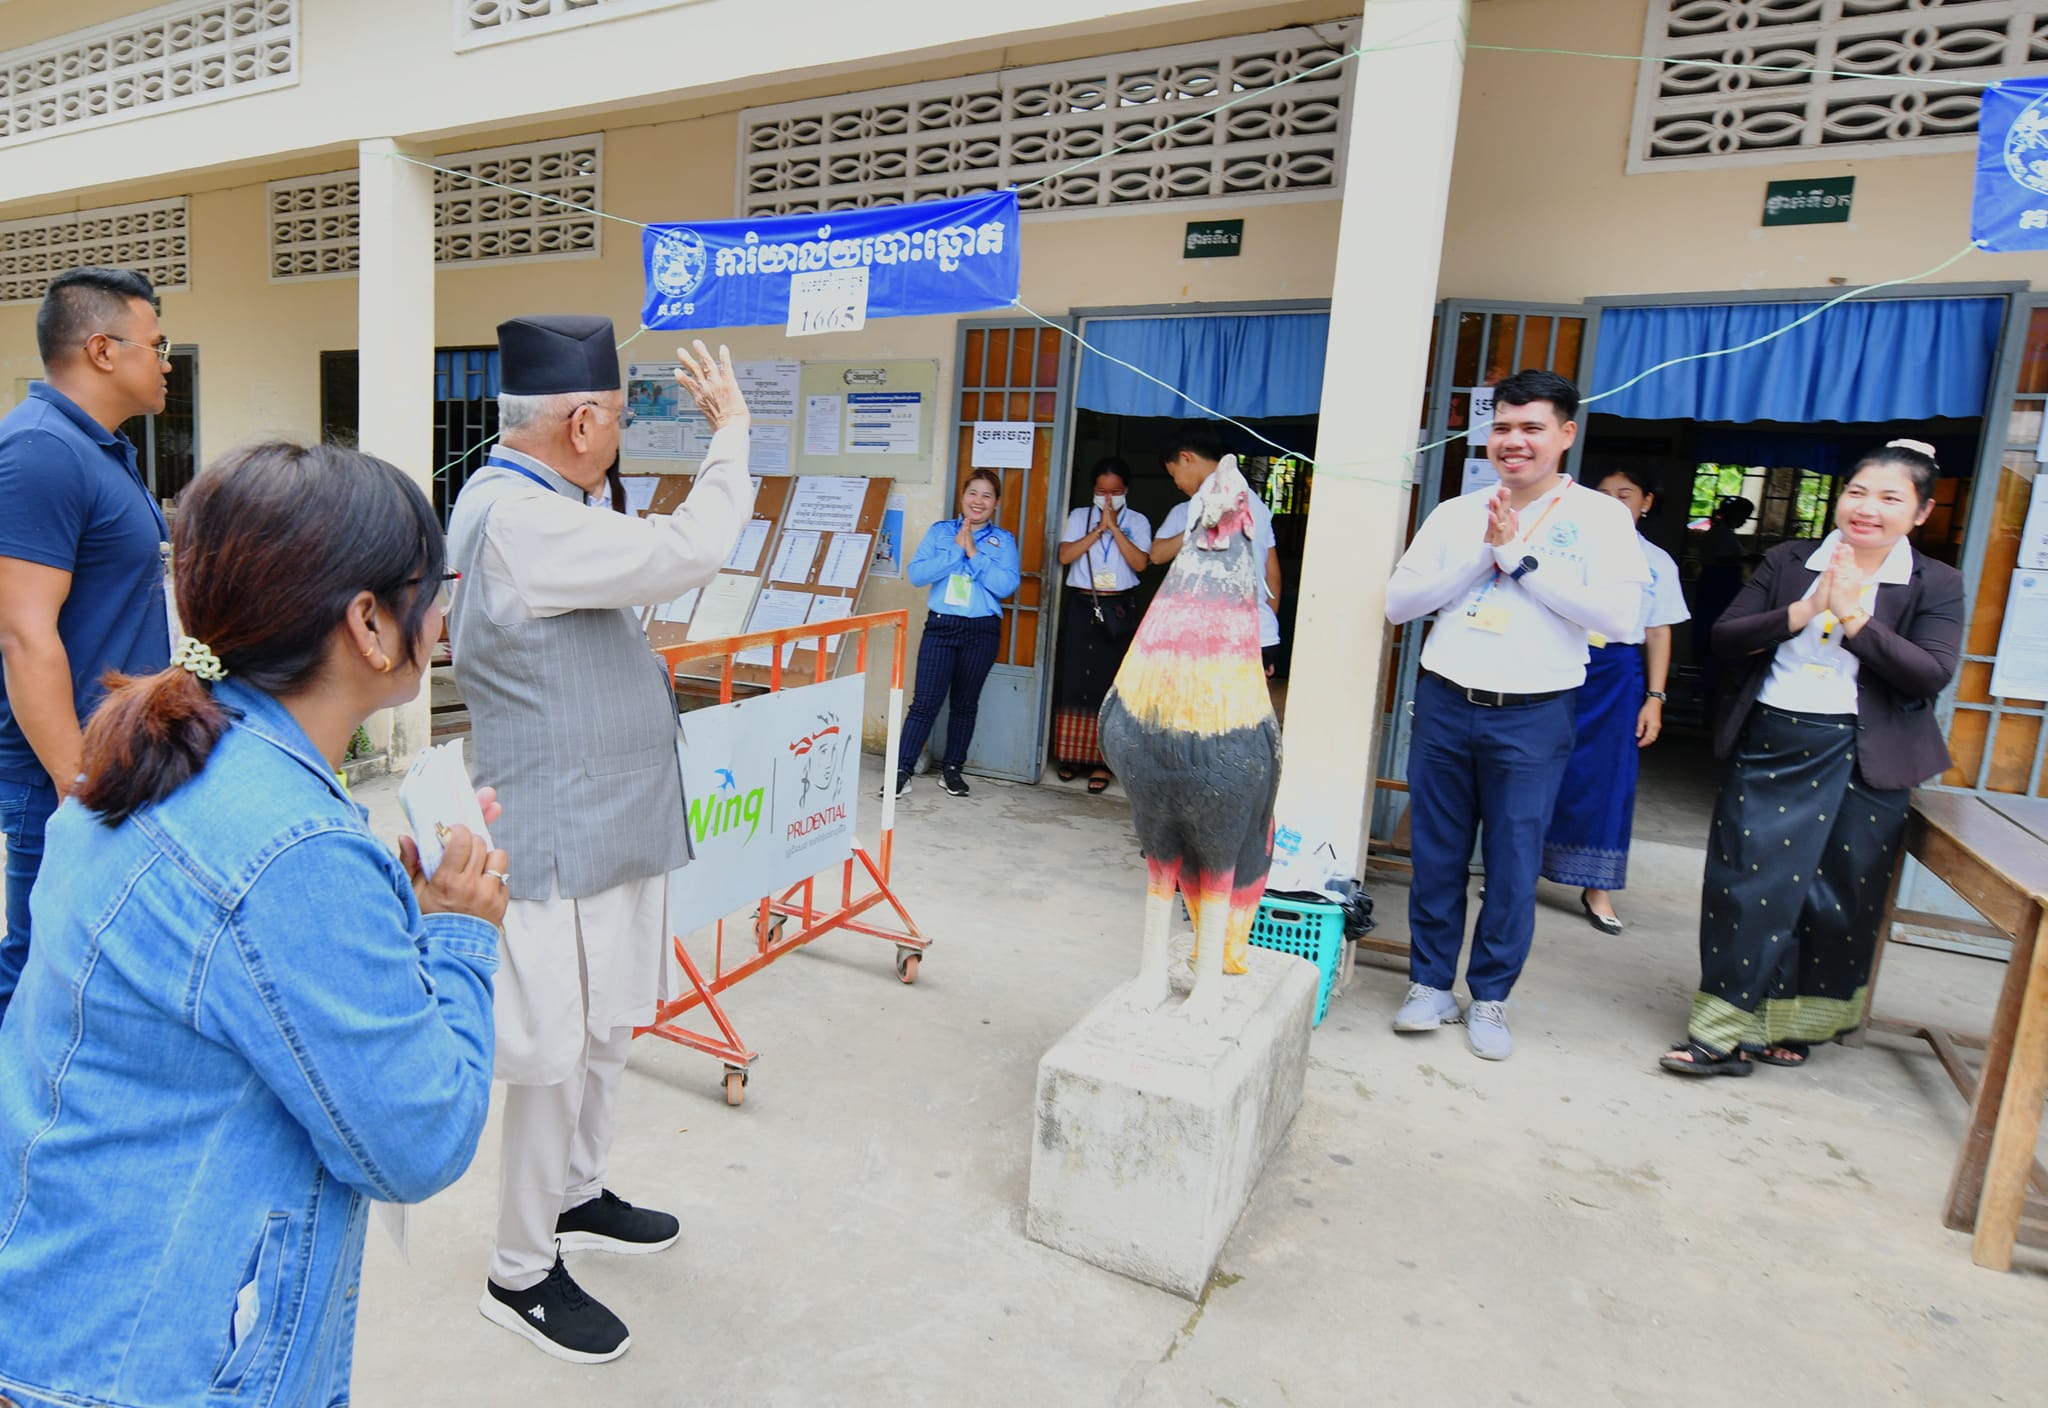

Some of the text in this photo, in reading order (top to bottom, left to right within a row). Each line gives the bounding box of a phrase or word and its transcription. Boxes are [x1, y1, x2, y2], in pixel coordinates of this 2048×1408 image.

[715, 221, 1006, 277] ការិយាល័យបោះឆ្នោត
[801, 306, 856, 332] 1665
[687, 786, 765, 848] Wing
[786, 802, 847, 841] PRUDENTIAL
